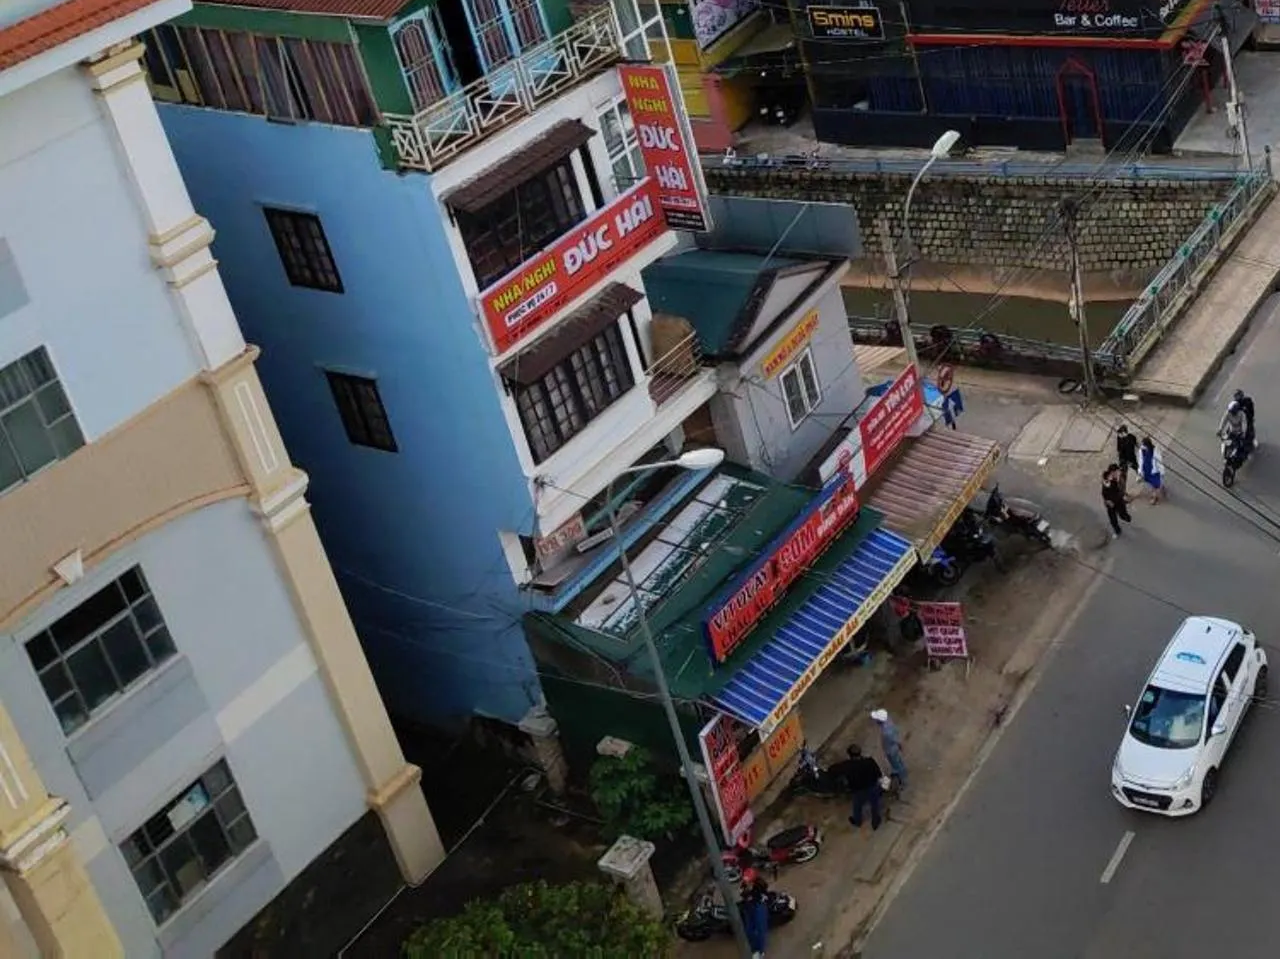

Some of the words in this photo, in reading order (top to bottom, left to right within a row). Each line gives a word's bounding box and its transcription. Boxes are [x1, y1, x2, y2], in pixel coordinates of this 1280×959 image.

[1054, 13, 1077, 26] Bar
[1081, 13, 1091, 26] &
[1094, 13, 1138, 27] Coffee
[826, 28, 869, 37] HOSTEL
